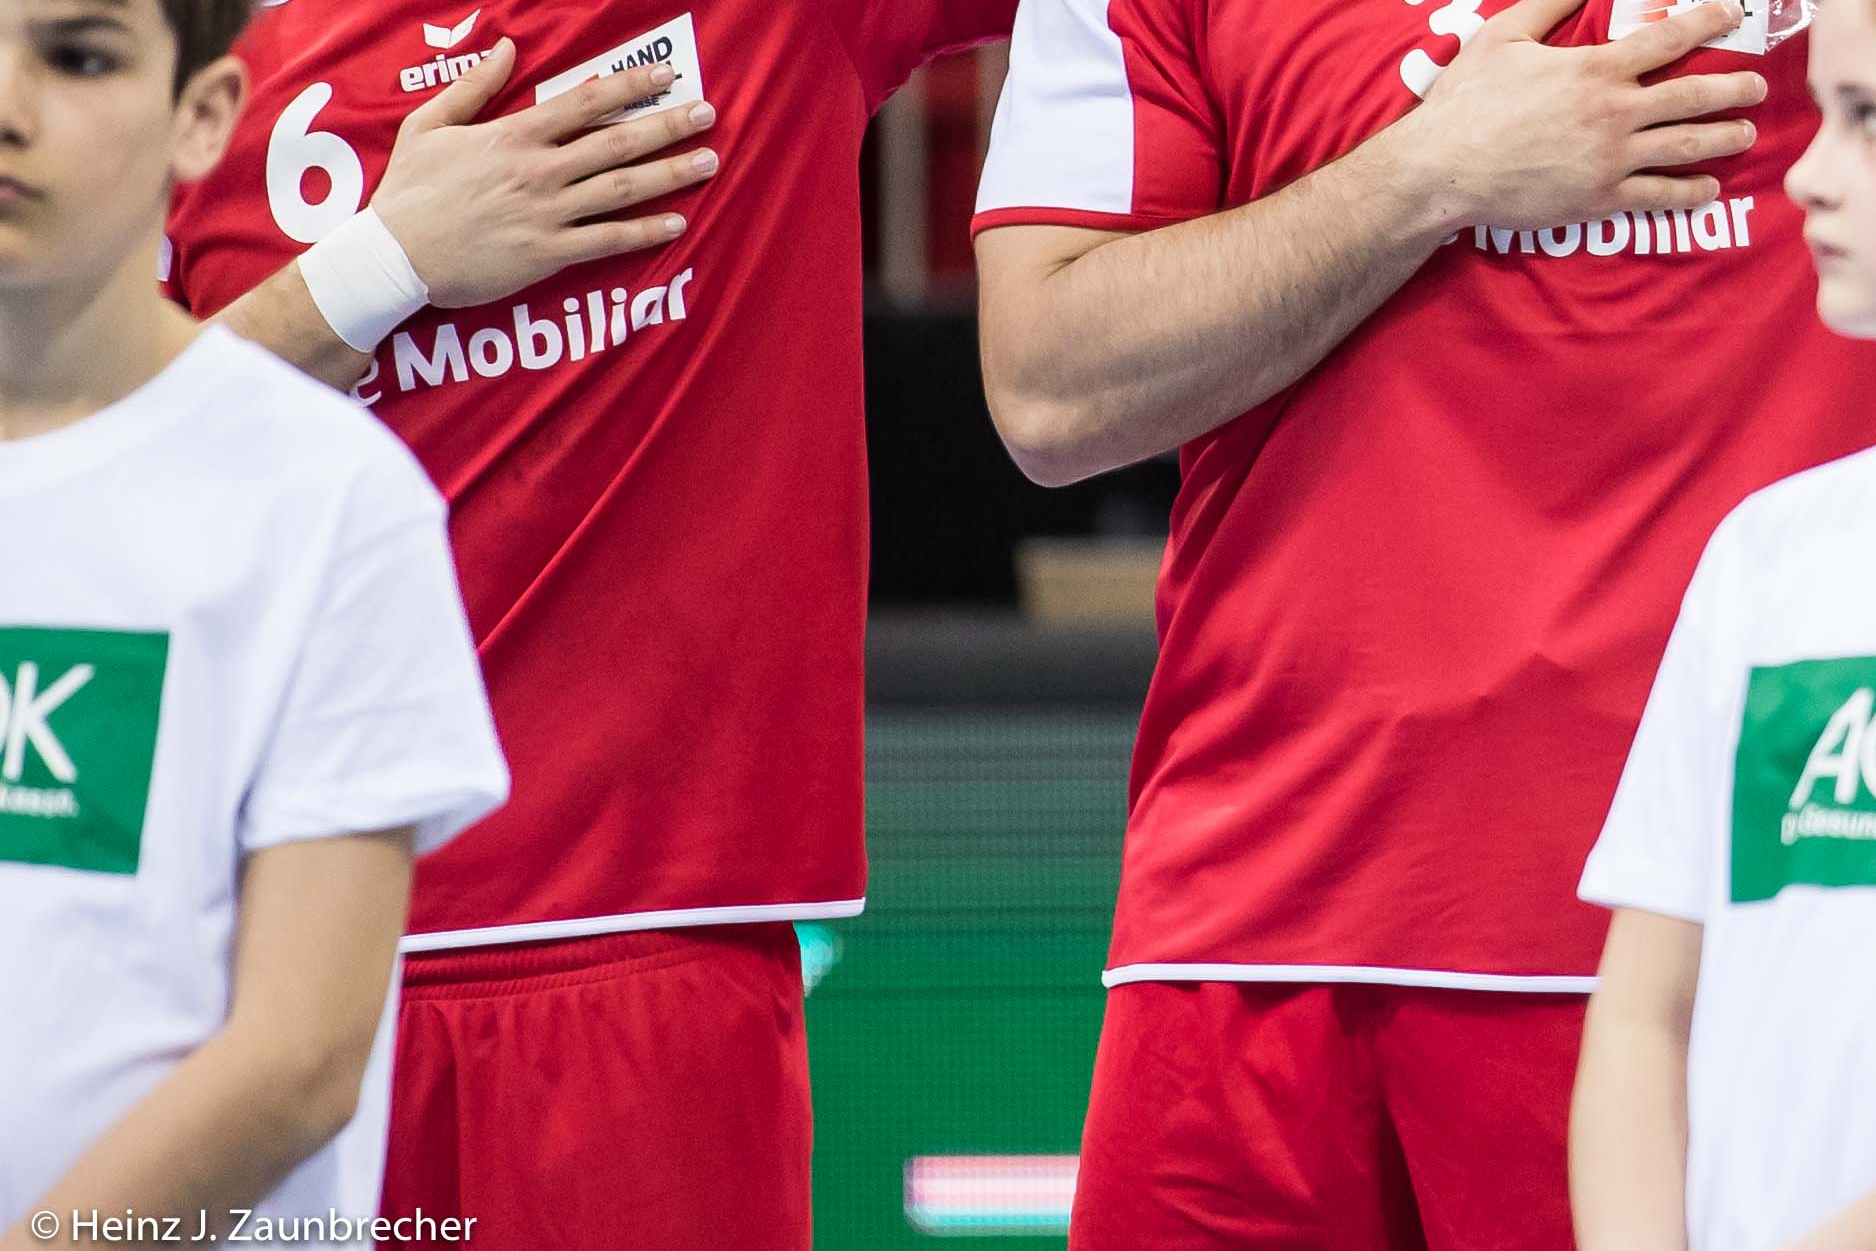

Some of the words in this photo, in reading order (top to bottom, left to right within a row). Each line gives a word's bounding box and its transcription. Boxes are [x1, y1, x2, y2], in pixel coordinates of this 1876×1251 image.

[399, 49, 493, 92] erim
[610, 36, 673, 74] HAND
[266, 81, 364, 244] 6
[393, 267, 694, 392] Mobiliar
